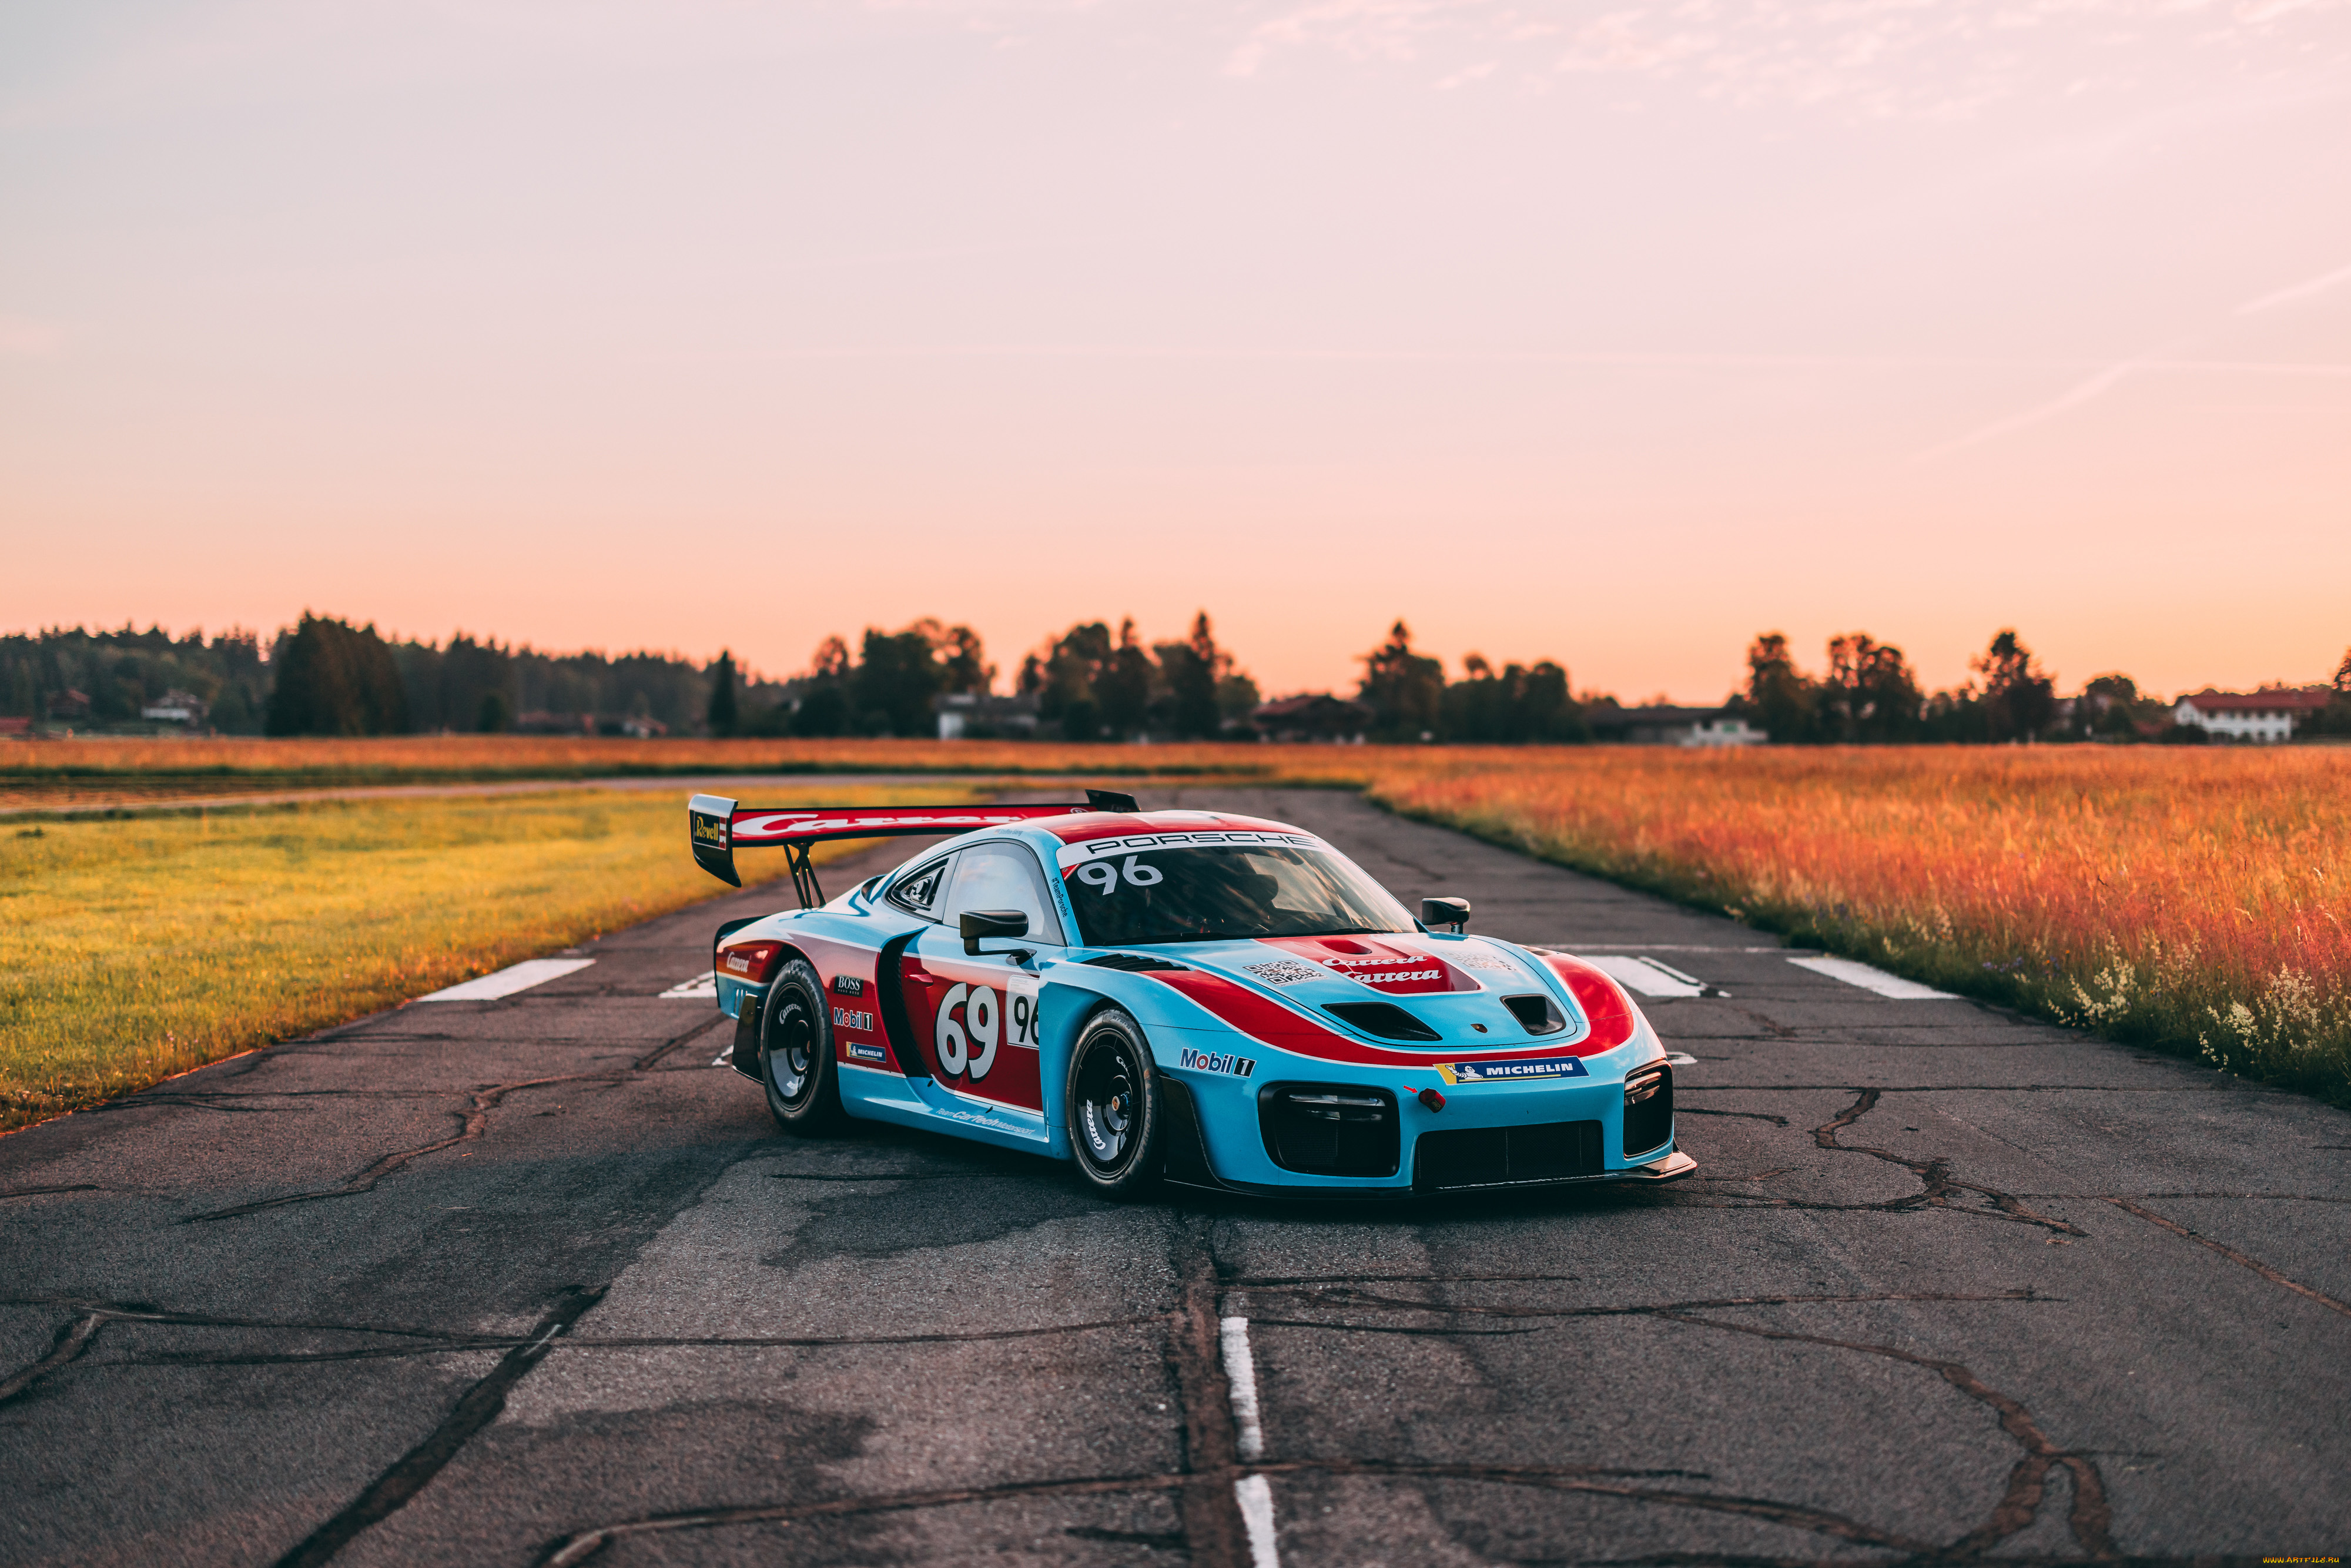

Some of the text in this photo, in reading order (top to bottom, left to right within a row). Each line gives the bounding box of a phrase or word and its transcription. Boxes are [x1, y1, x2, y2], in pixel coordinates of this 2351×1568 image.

[697, 816, 718, 840] Revell
[732, 814, 1045, 836] Carrer
[1086, 833, 1319, 855] PORSCHE
[1077, 855, 1163, 896] 96
[1051, 877, 1069, 918] #TeamPorsche
[726, 951, 749, 973] Carrera
[1322, 956, 1428, 967] Carrera
[838, 976, 860, 990] BOSS
[779, 1004, 802, 1024] Carrera
[834, 1007, 862, 1029] Mobil
[935, 982, 999, 1082] 69
[858, 1048, 883, 1057] MICHELIN
[1180, 1047, 1235, 1075] Mobil
[1486, 1063, 1573, 1076] MICHELIN
[1087, 1099, 1106, 1150] Carrera
